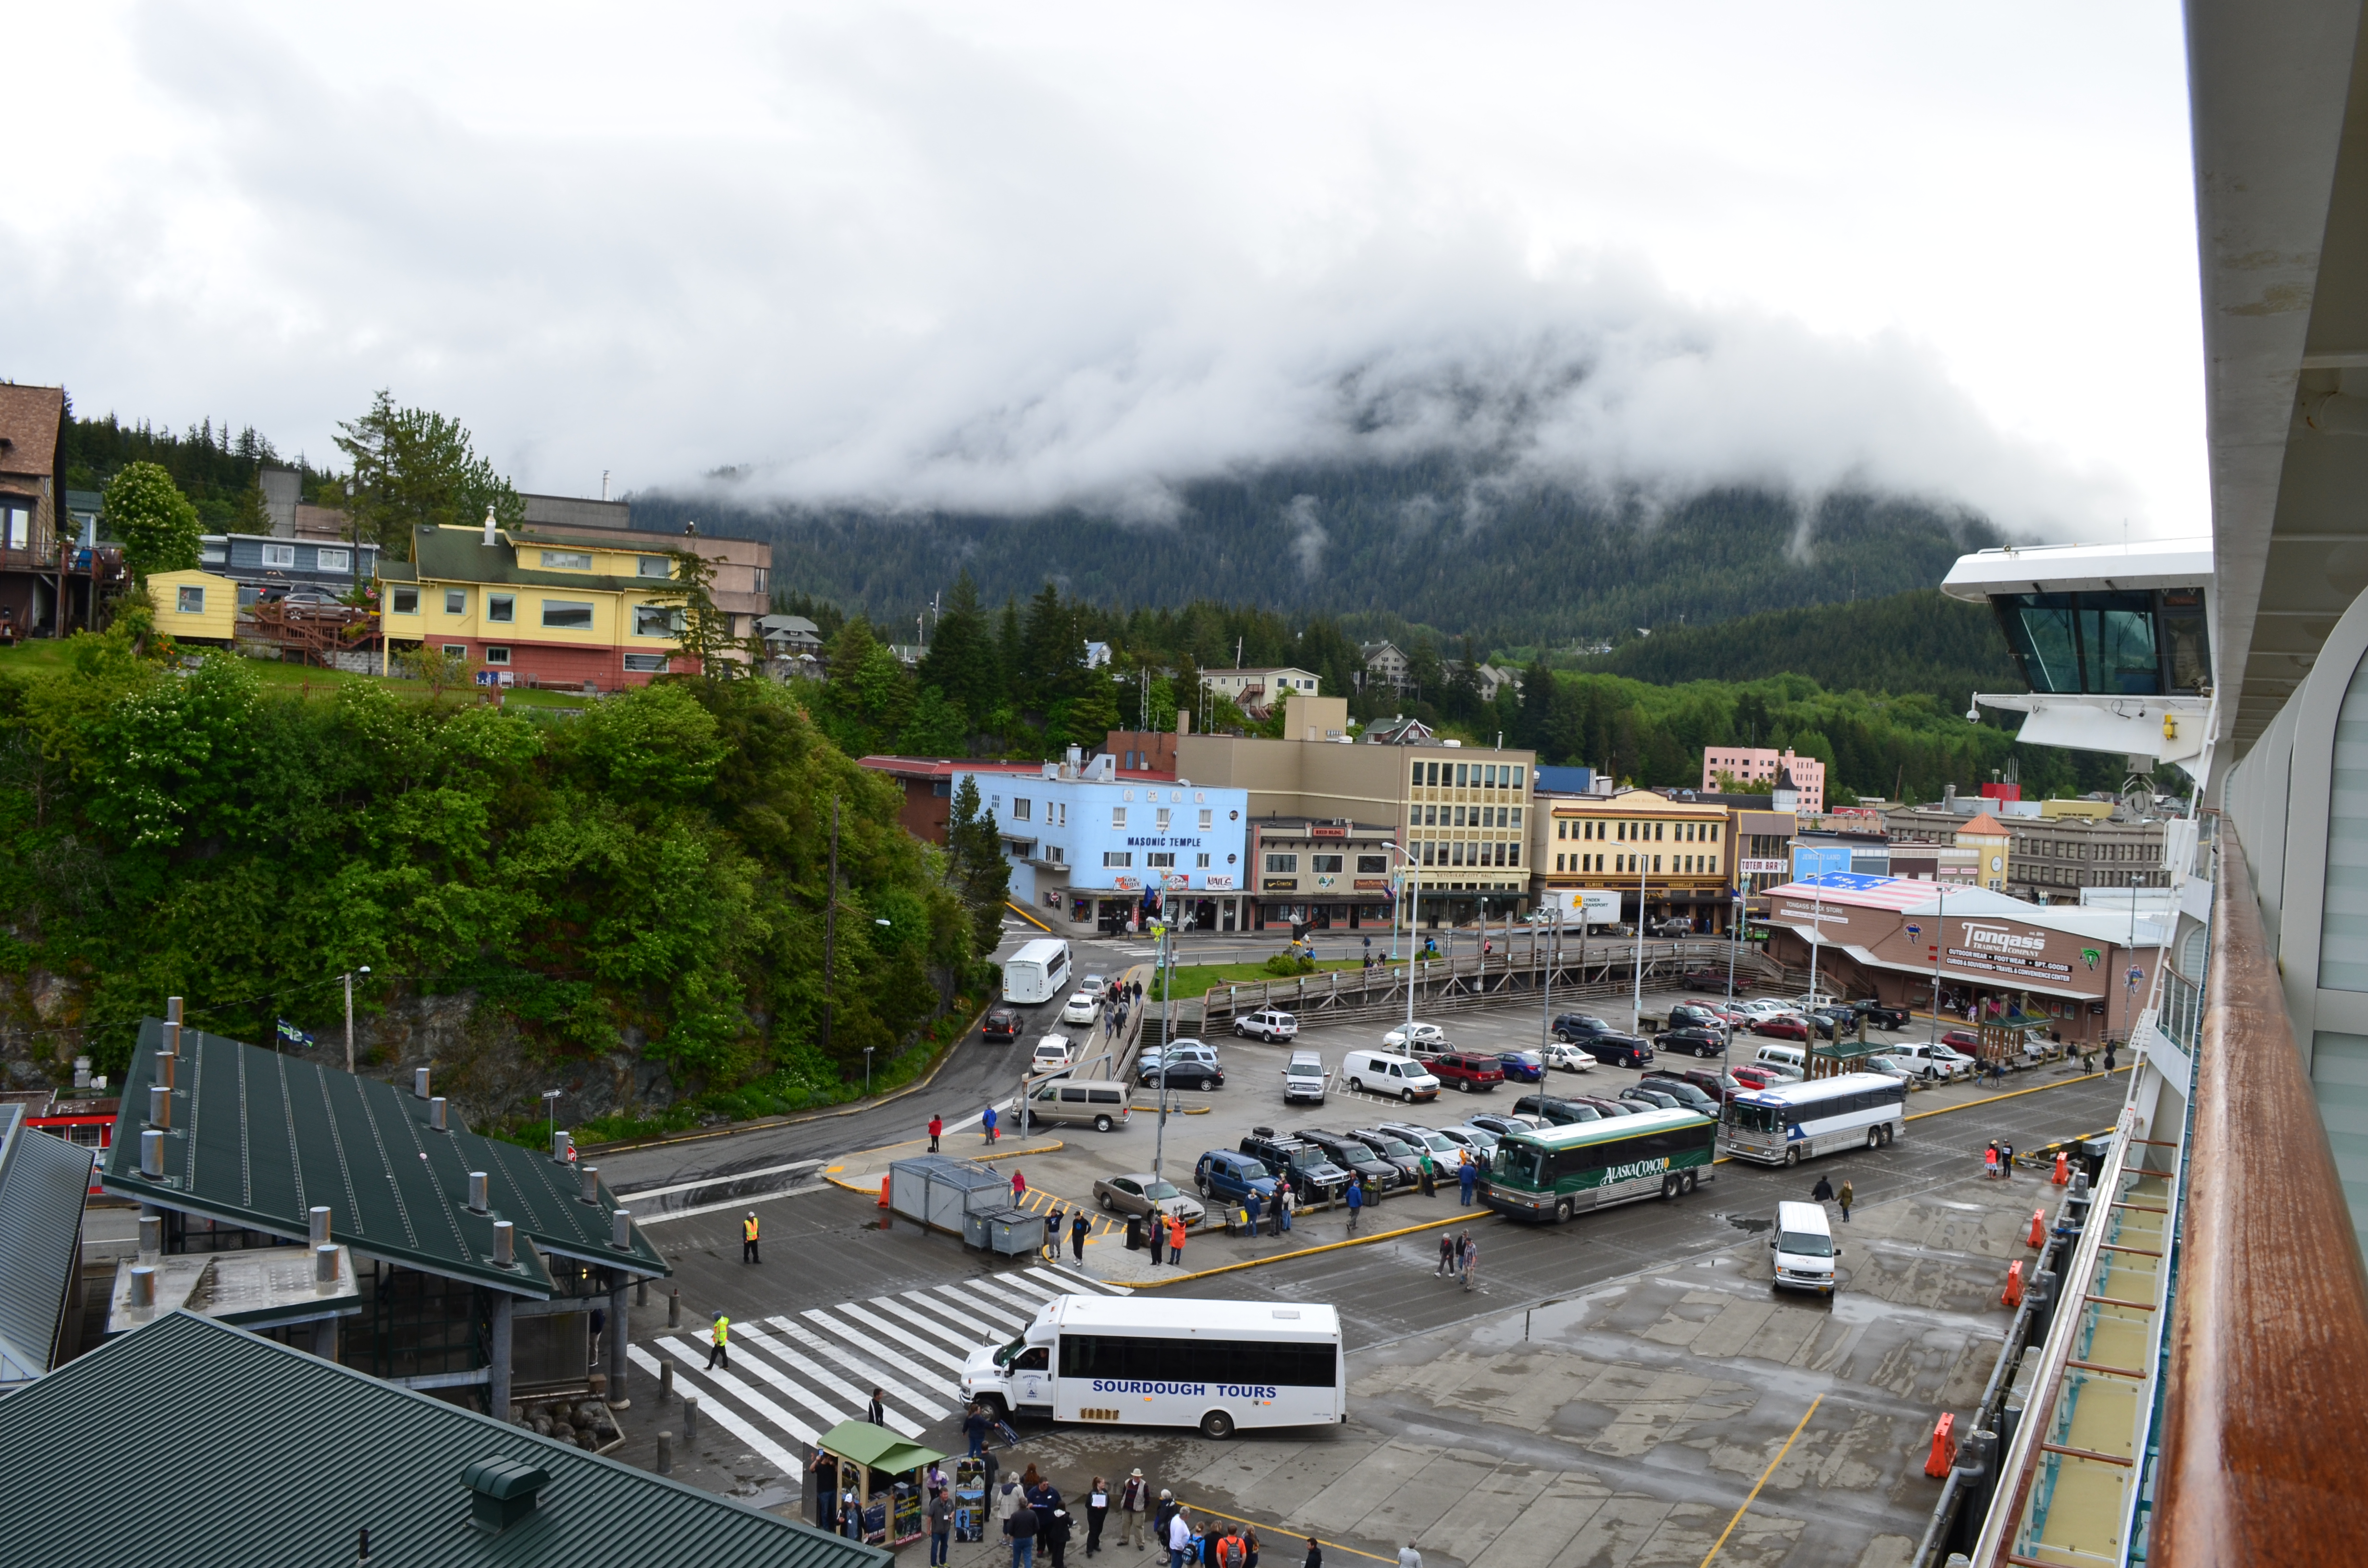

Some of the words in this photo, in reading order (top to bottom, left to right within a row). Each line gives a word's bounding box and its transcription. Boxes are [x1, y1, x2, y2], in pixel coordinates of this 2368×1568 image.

[1128, 837, 1165, 846] MASONIC
[1170, 838, 1201, 847] TEMPLE
[1742, 861, 1762, 870] TOTEM
[1765, 862, 1778, 870] BAR
[1207, 876, 1232, 886] NAILS
[1786, 901, 1810, 910] TONGASS
[1961, 922, 2046, 953] Tongass
[1973, 942, 2001, 952] TRADING
[2008, 947, 2040, 957] COMPANY
[1949, 948, 1973, 957] OUTDOOR
[2048, 963, 2068, 971] GOODS
[1967, 961, 1992, 970] SOUVENIRS
[1996, 965, 2013, 973] TRAVEL
[2018, 968, 2051, 979] CONVENIENCE
[2051, 973, 2070, 982] CENTER
[1600, 1164, 1636, 1187] ALASKA
[1636, 1157, 1665, 1177] COACH
[1092, 1380, 1205, 1396] SOURDOUGH
[1216, 1385, 1276, 1398] TOURS
[898, 1495, 918, 1504] Experience
